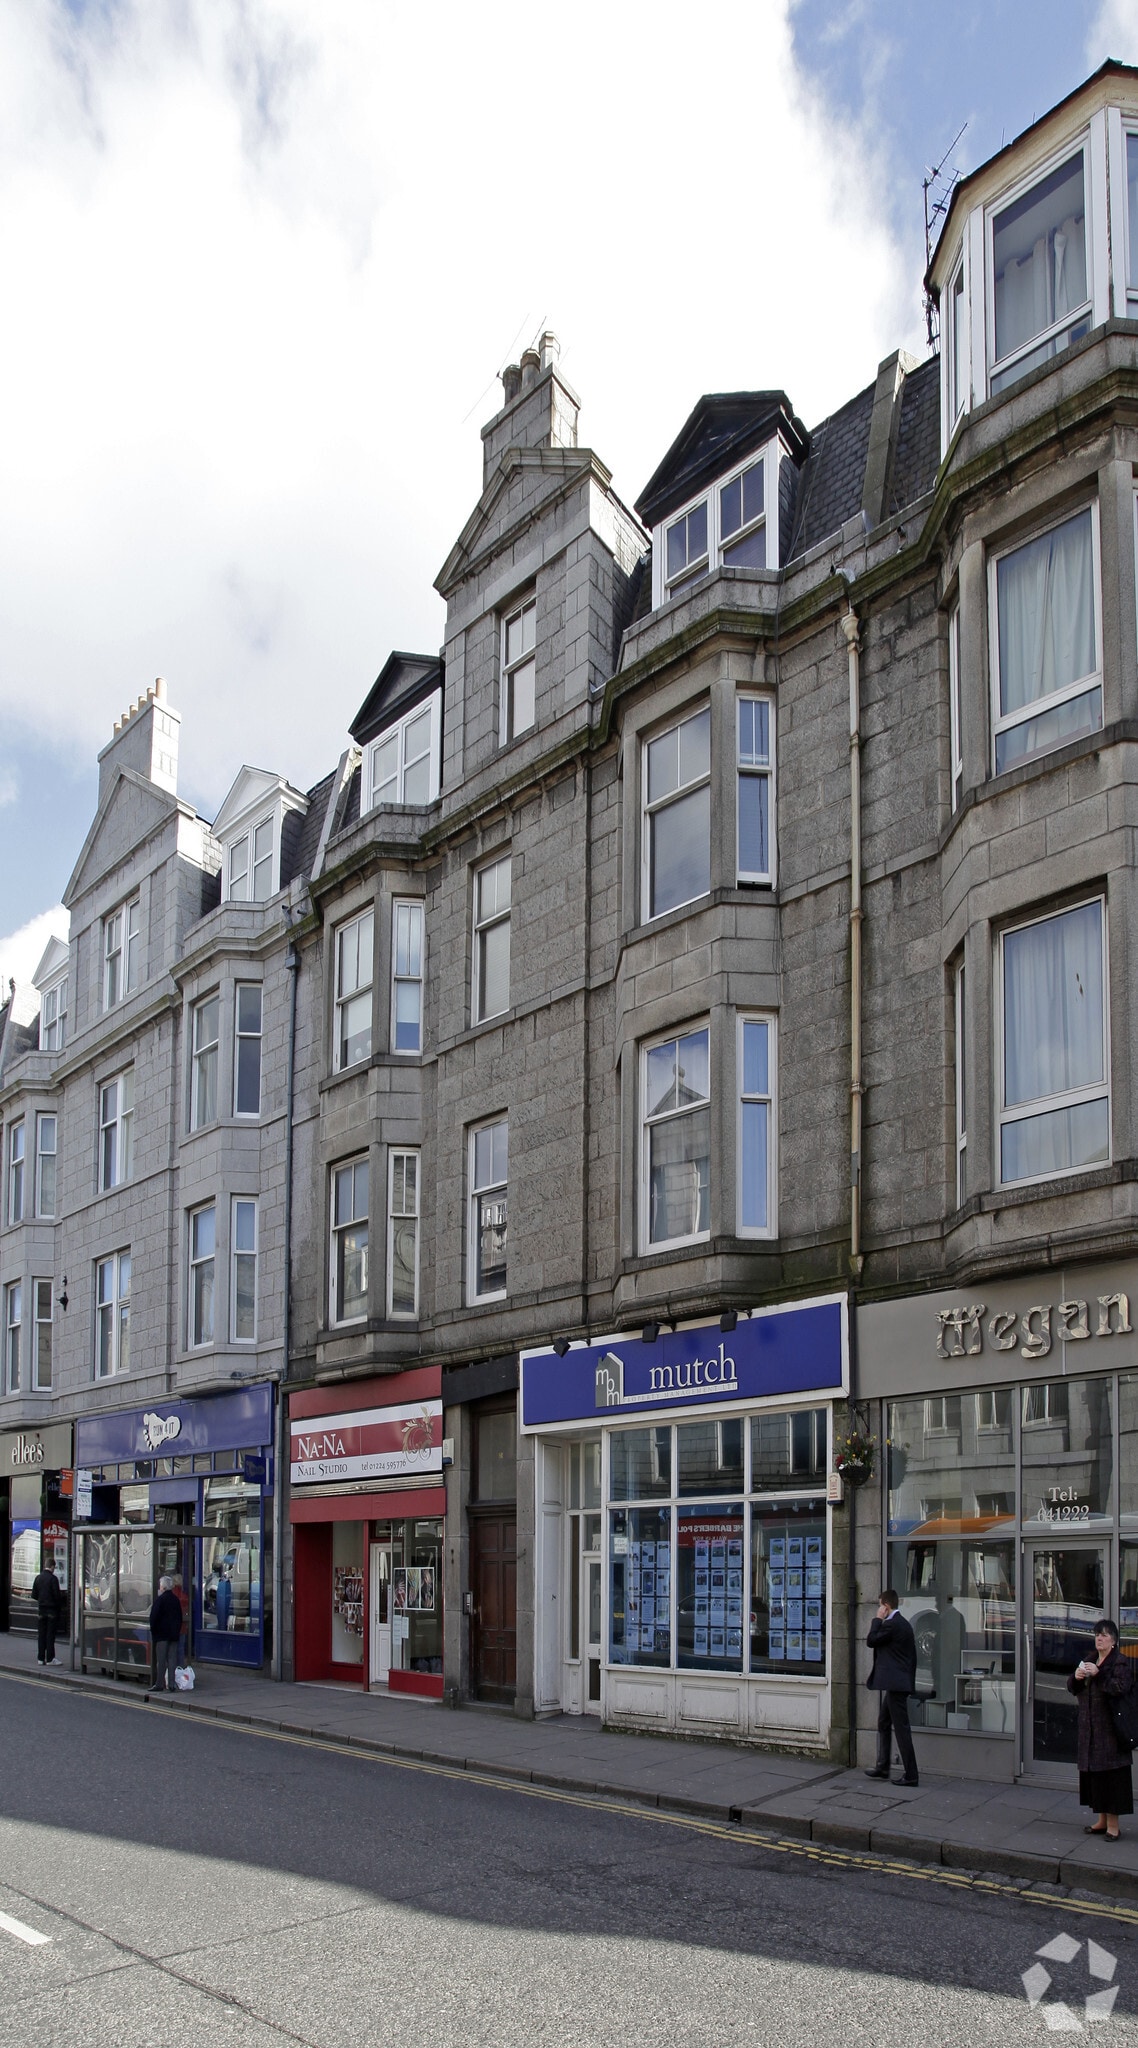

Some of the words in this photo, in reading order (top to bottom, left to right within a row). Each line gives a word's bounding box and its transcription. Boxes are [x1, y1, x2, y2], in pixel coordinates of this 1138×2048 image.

[934, 1293, 1133, 1358] Megan
[649, 1343, 738, 1390] mutch
[664, 1385, 718, 1398] MANAGEMENT
[169, 1422, 175, 1434] IT
[11, 1432, 44, 1465] ellee's
[318, 1463, 348, 1477] STUDIO
[1048, 1486, 1078, 1502] Tel:
